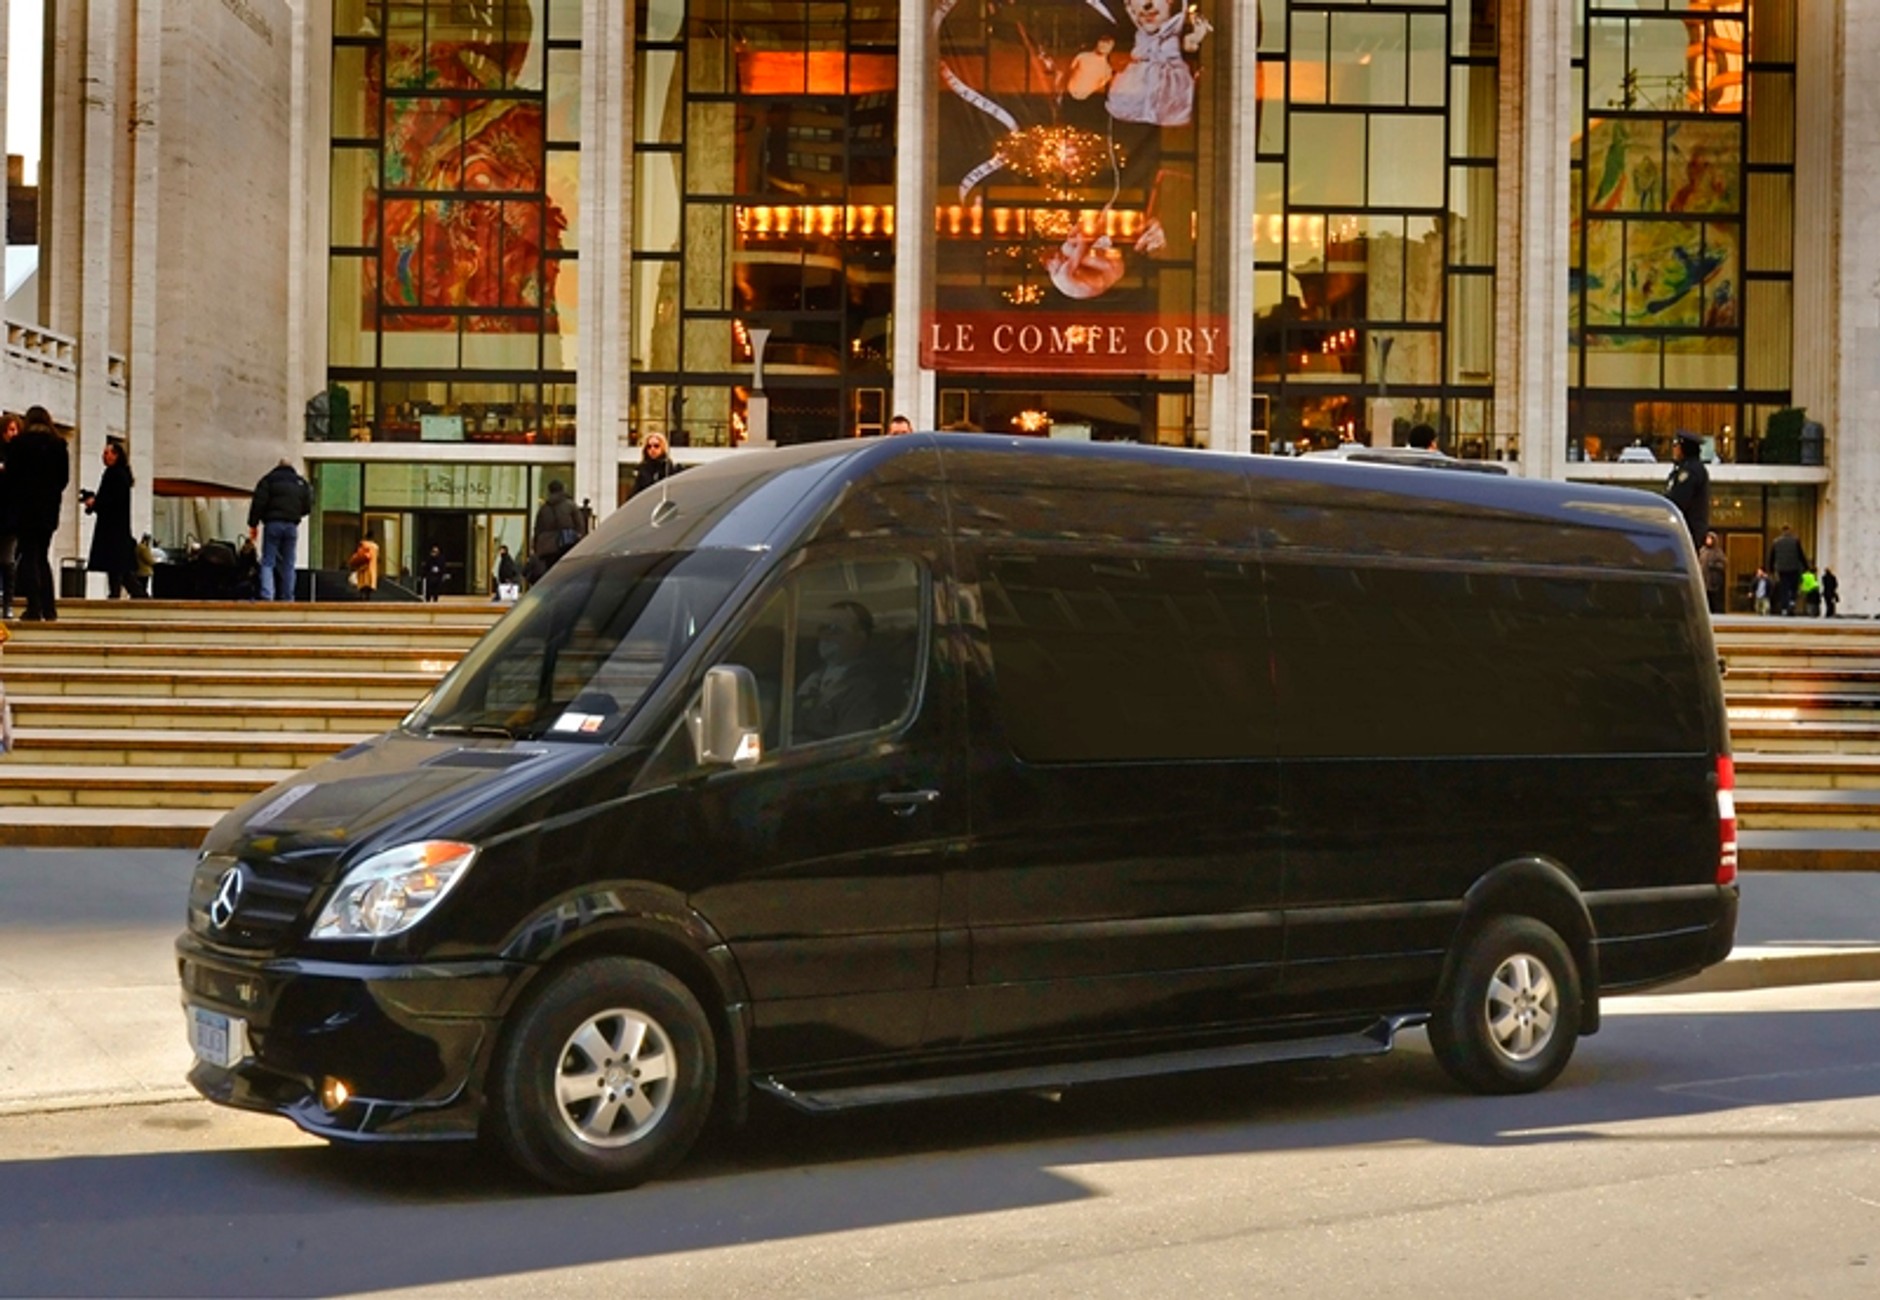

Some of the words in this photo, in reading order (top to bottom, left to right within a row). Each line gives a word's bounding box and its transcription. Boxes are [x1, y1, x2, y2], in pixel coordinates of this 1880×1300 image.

[931, 324, 975, 352] LE
[993, 324, 1128, 354] COMTE
[1145, 326, 1221, 355] ORY
